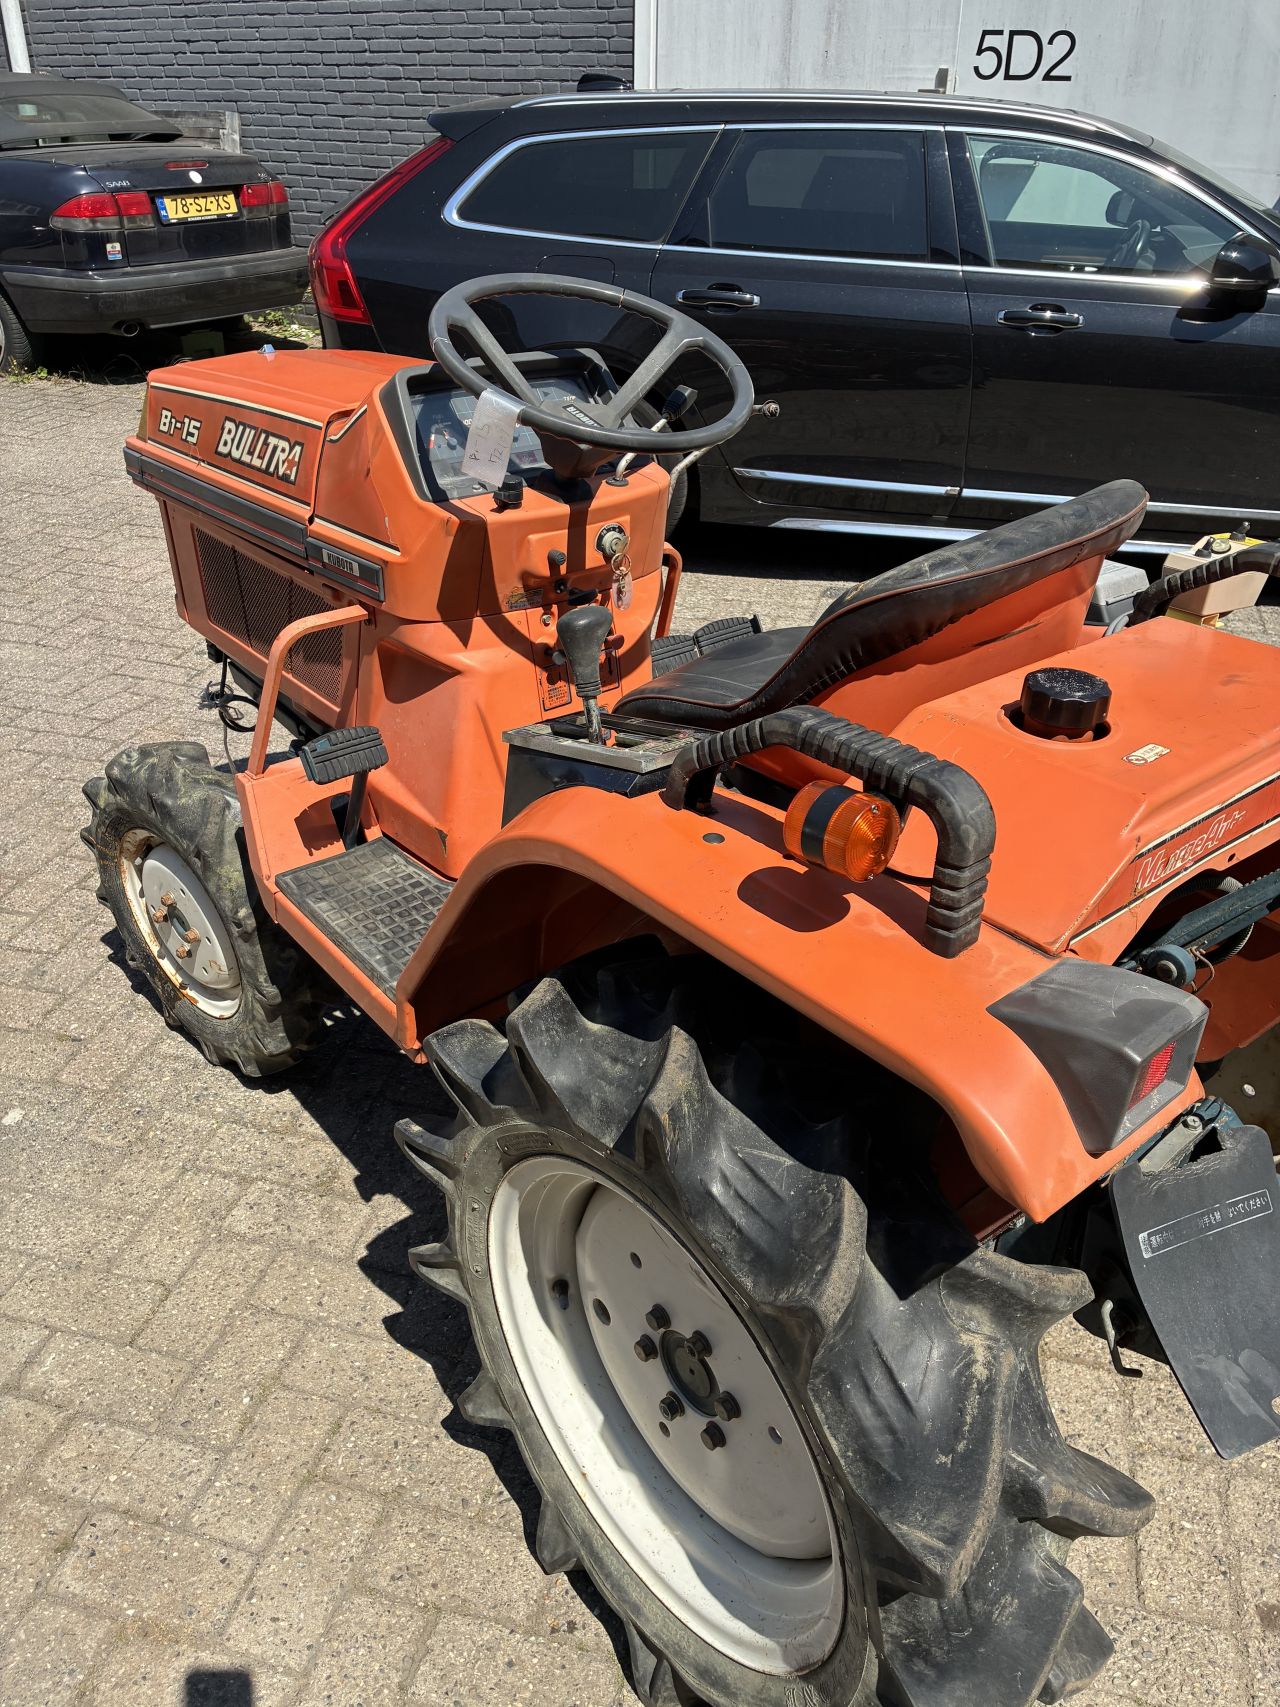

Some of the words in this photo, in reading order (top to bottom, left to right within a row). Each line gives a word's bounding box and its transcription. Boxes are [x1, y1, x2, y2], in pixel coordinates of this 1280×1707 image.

[973, 29, 1077, 81] 5D2
[106, 180, 131, 188] SAAB
[170, 194, 232, 215] 78-SZ-XS
[159, 408, 202, 445] B1-15
[215, 417, 304, 485] BULLTRA
[327, 551, 354, 574] KUBOTA
